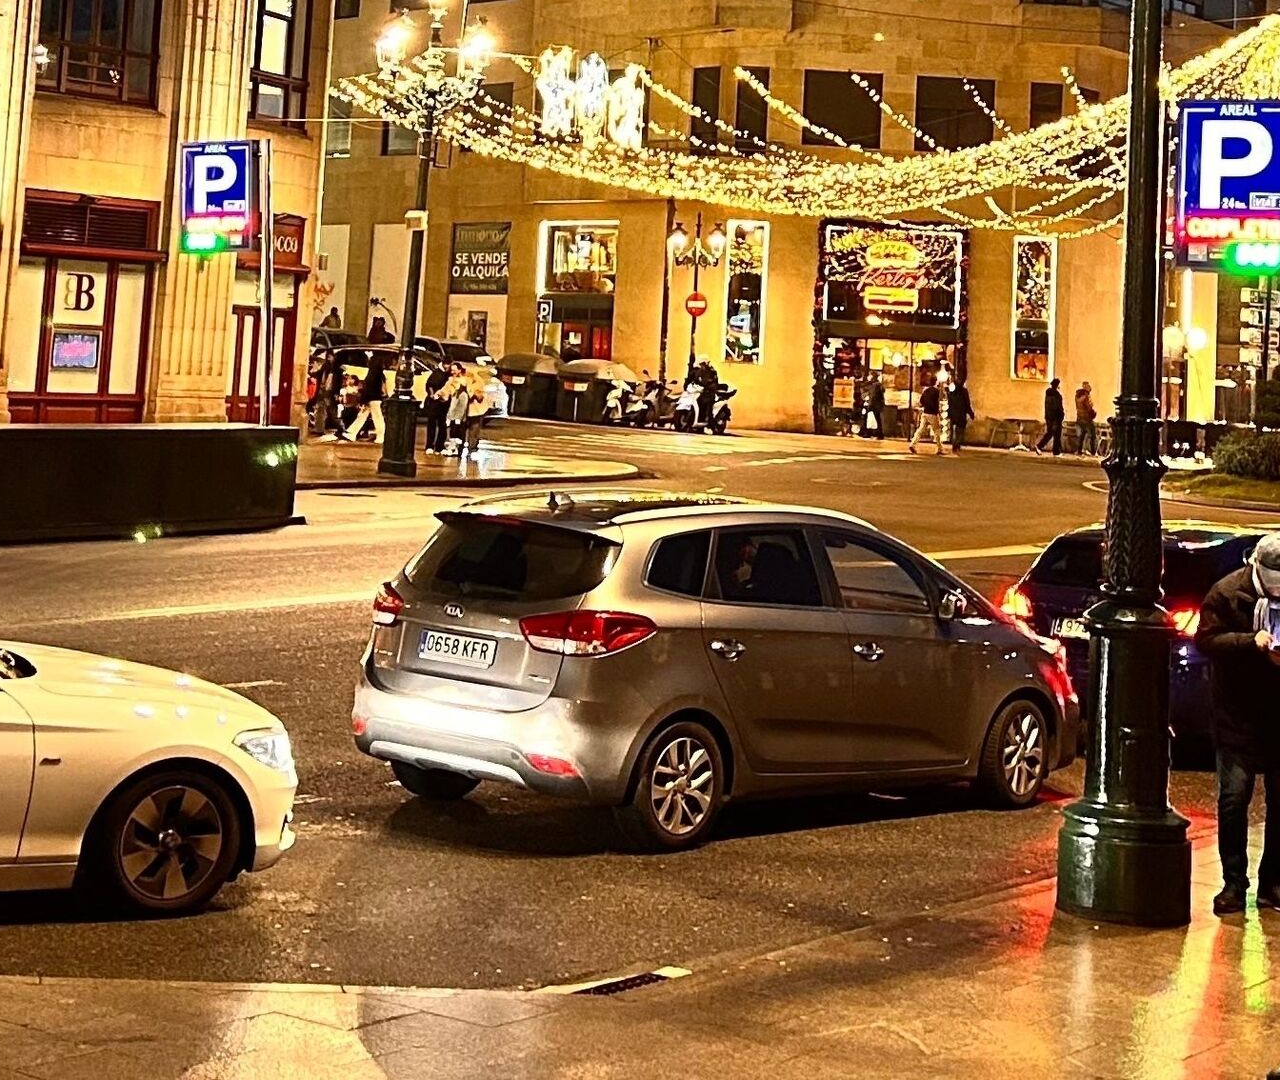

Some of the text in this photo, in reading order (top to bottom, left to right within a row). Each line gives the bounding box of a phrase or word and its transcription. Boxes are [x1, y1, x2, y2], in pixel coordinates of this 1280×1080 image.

[1219, 104, 1258, 116] AREAL
[1199, 120, 1273, 209] P
[193, 154, 238, 213] P
[455, 252, 507, 264] SE VENDE
[452, 265, 509, 279] O ALQUILA
[446, 606, 463, 617] KIA
[426, 634, 489, 660] 0658 KFR
